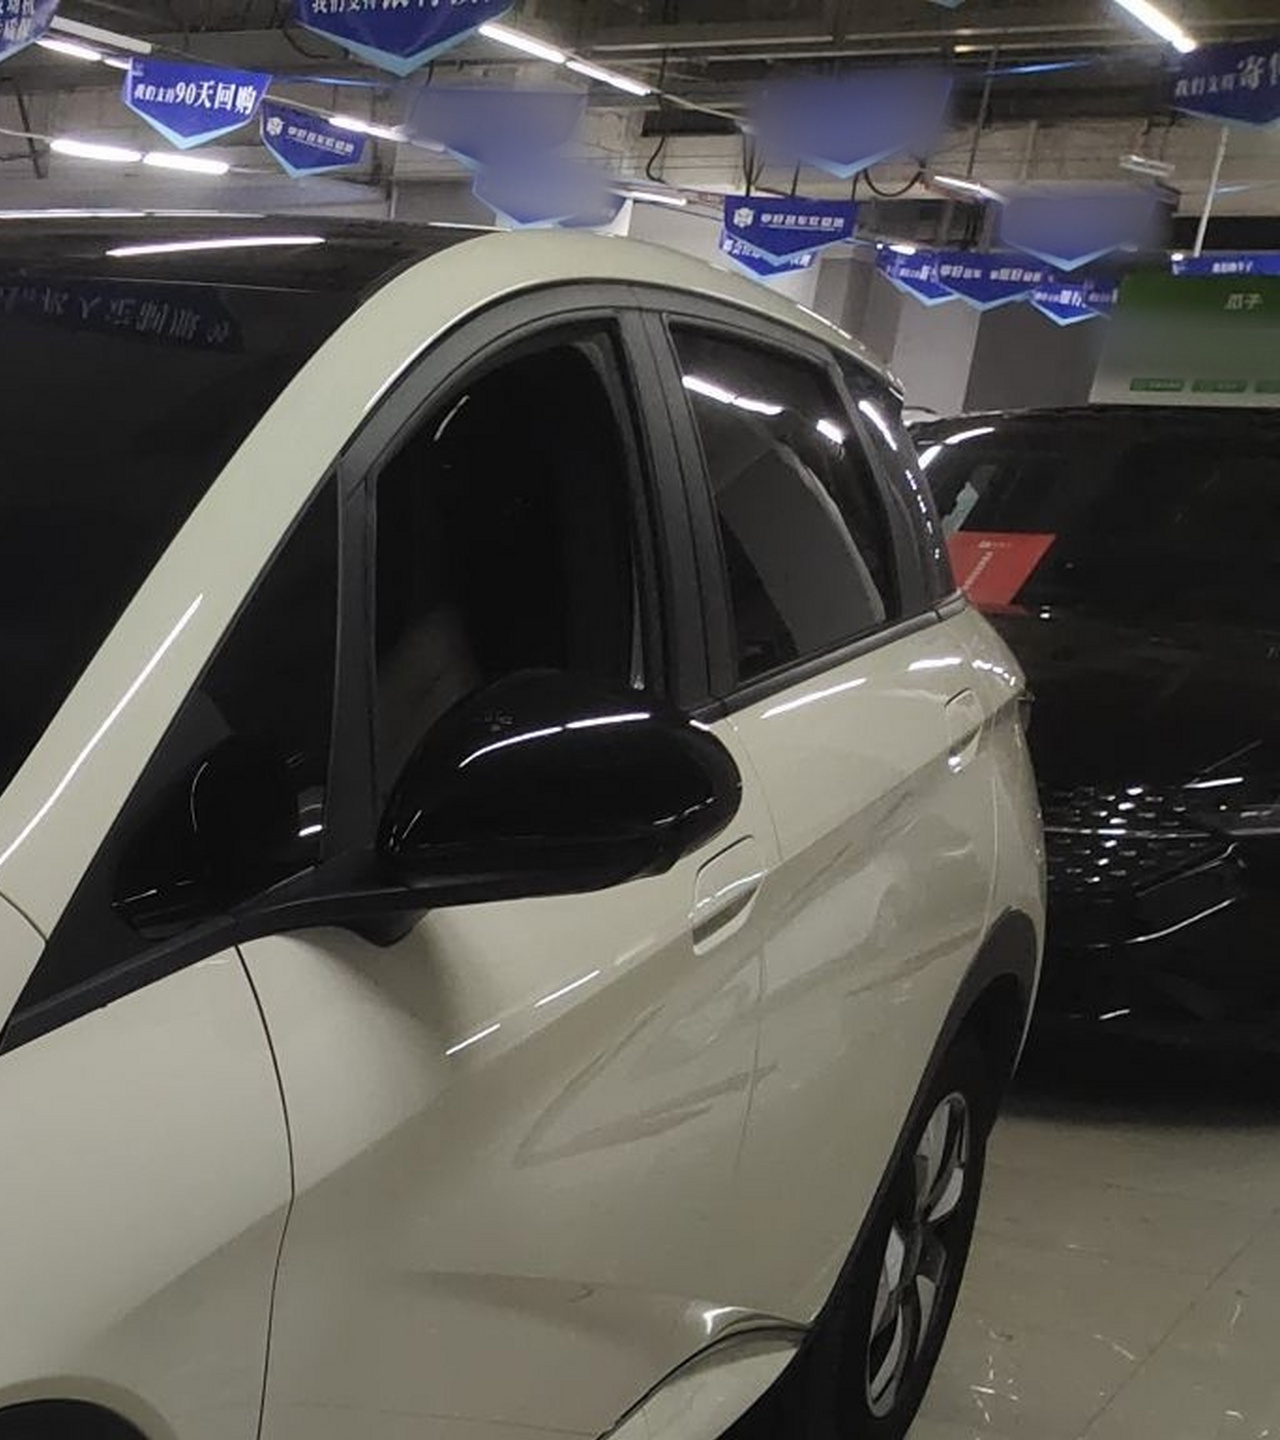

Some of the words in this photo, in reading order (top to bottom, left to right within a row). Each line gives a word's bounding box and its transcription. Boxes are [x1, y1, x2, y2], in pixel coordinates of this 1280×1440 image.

[133, 80, 257, 115] 我们支持90天回购
